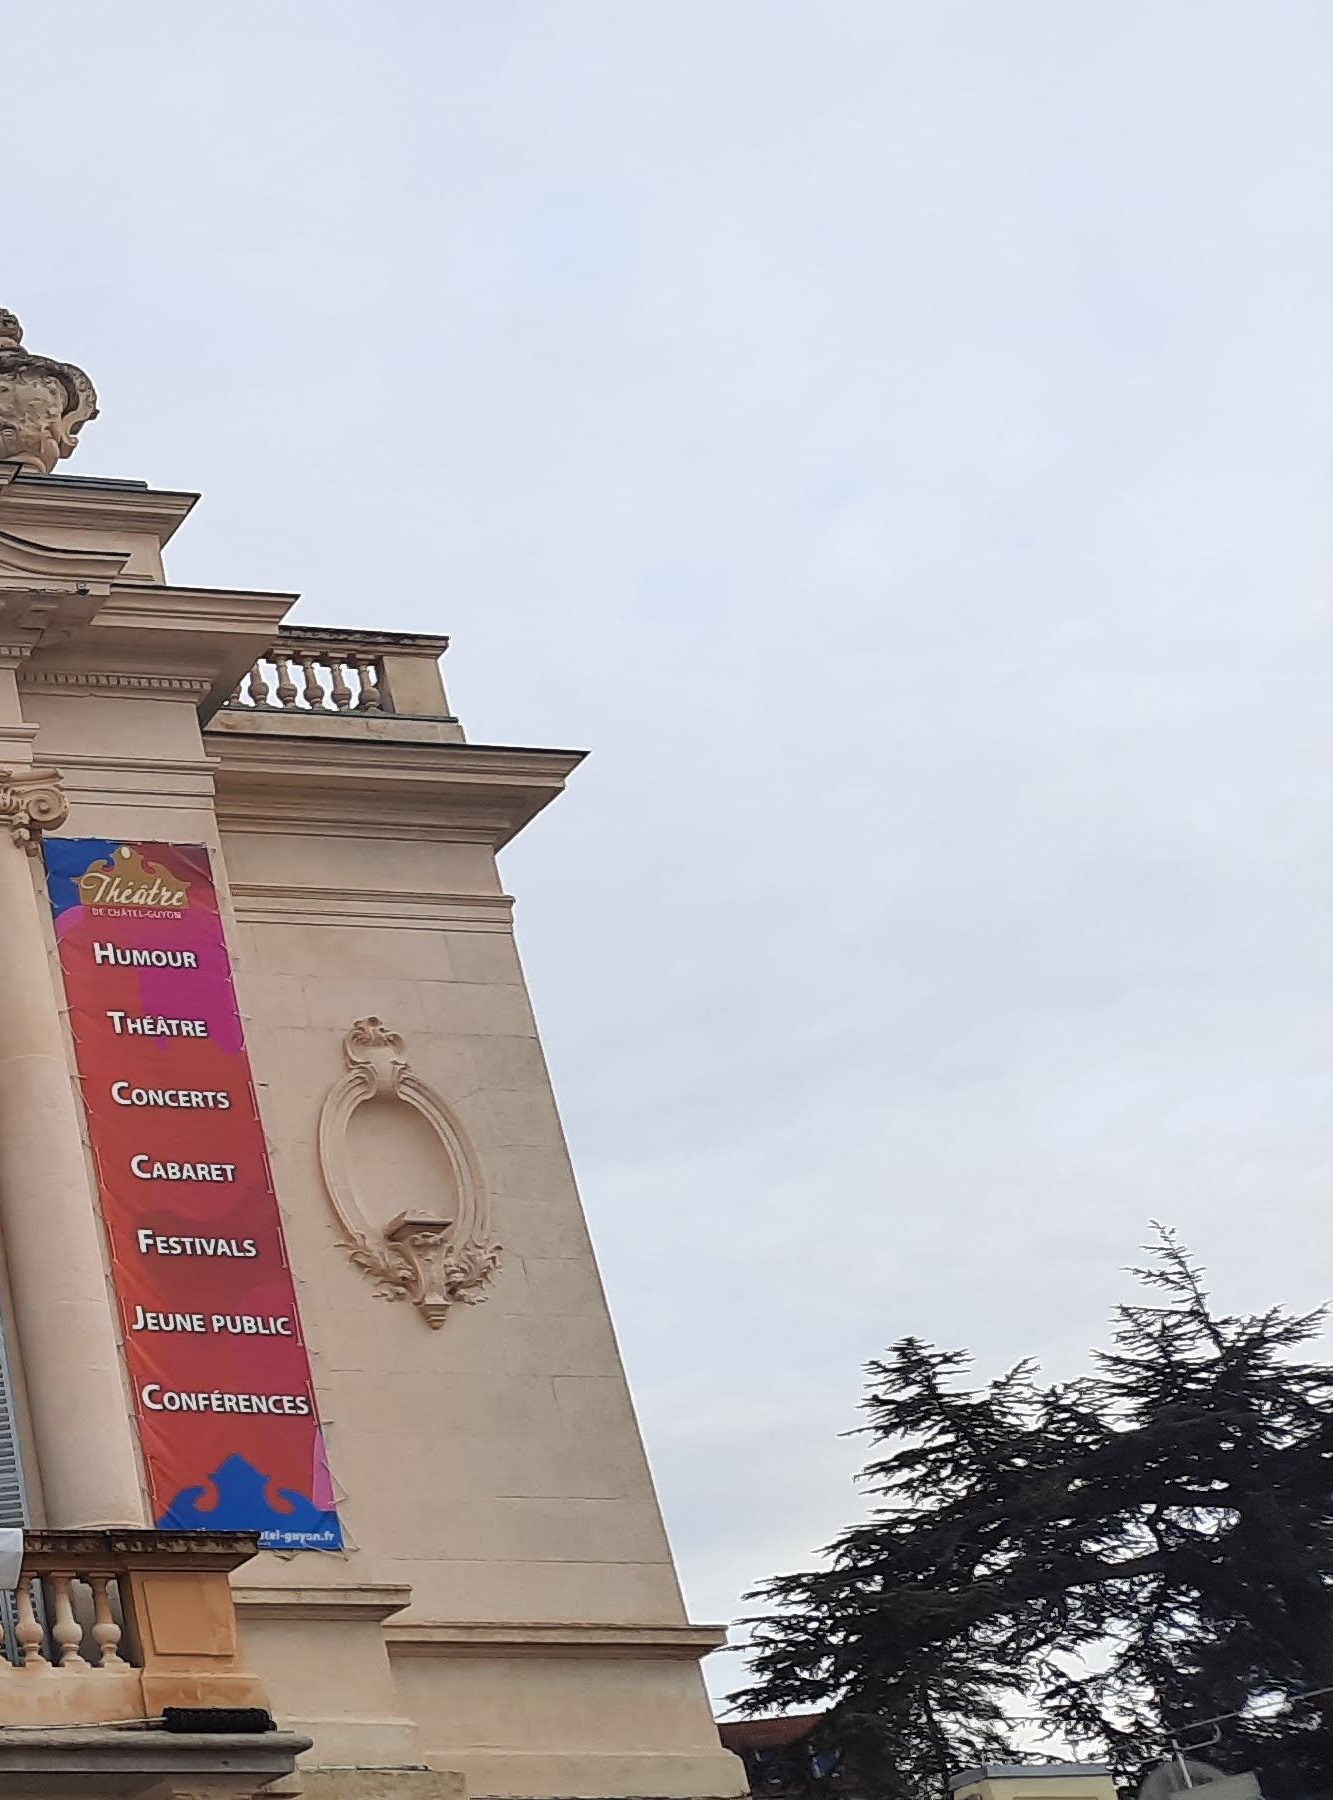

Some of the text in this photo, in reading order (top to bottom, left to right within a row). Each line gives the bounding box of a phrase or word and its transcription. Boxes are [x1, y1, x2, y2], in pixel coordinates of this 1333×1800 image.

[80, 872, 184, 906] Théâtre
[93, 942, 197, 968] HUMOUR
[106, 1011, 208, 1037] THÉÂTRE
[111, 1081, 230, 1109] CONCERTS
[130, 1154, 235, 1182] CABARET
[137, 1229, 257, 1257] FESTIVALS
[132, 1305, 292, 1335] JEUNE PUBLIC
[141, 1384, 309, 1415] CONFÉRENCES
